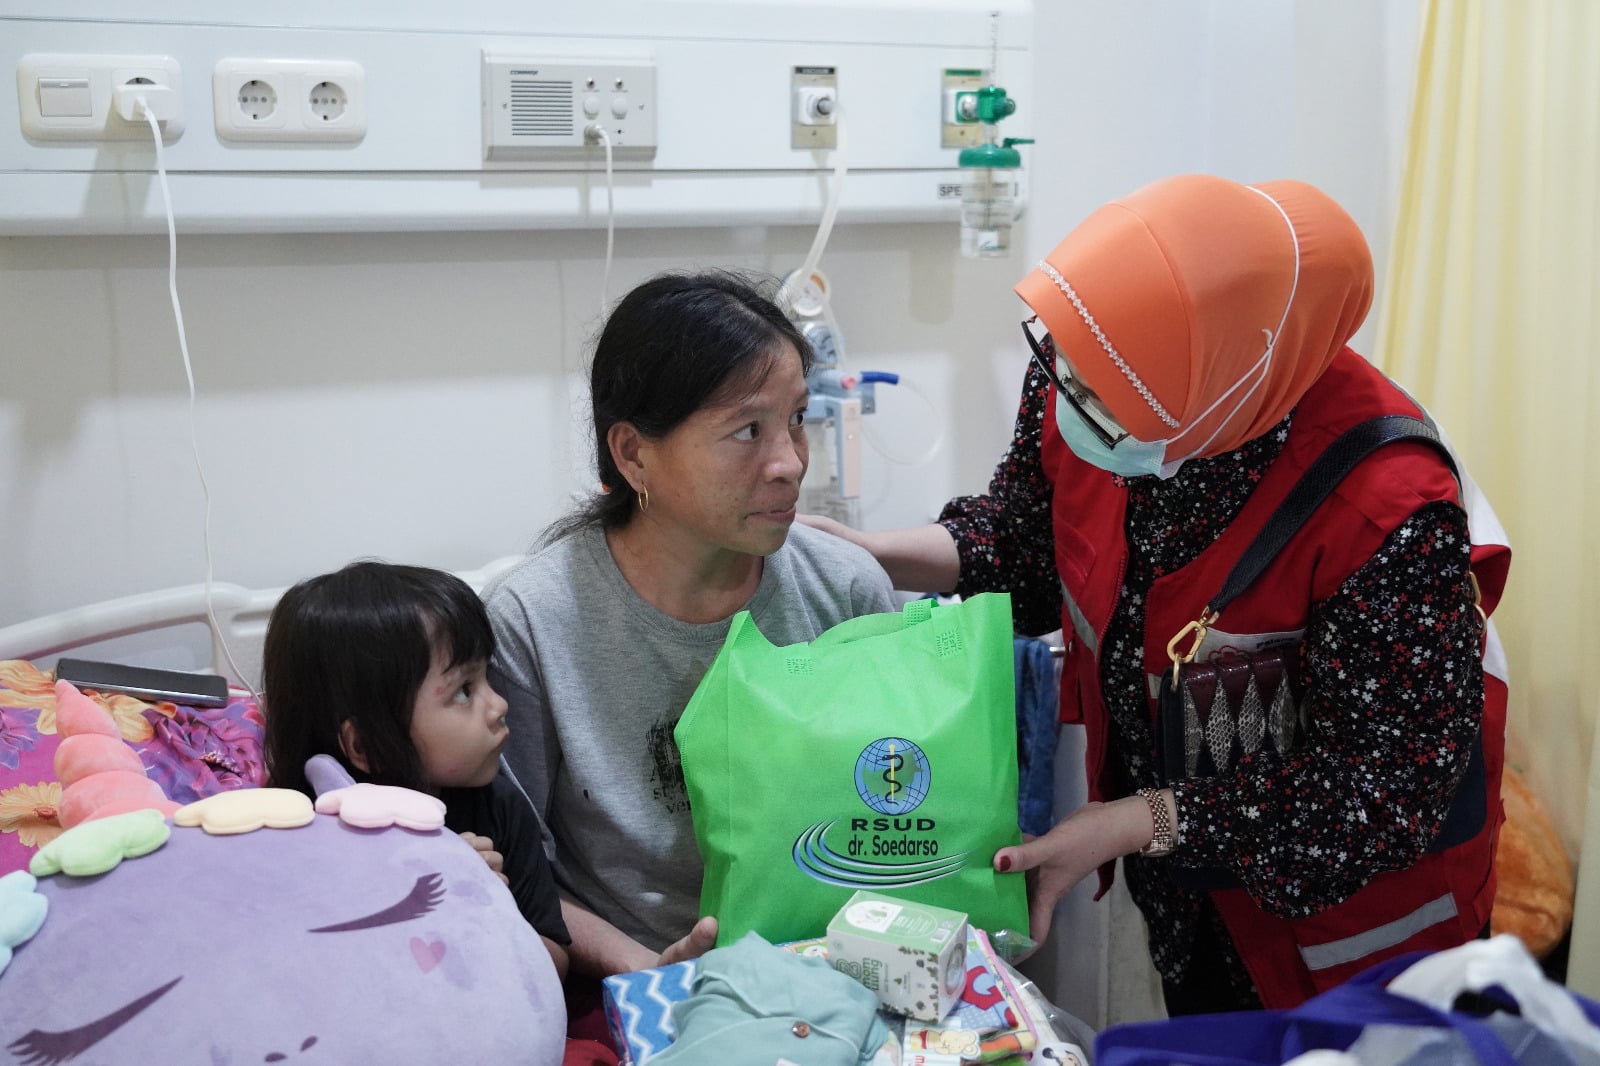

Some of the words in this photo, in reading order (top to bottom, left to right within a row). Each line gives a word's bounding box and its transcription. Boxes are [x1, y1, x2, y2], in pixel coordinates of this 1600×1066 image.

[851, 818, 935, 831] RSUD
[848, 835, 867, 856] dr.
[872, 834, 938, 856] Soedarso
